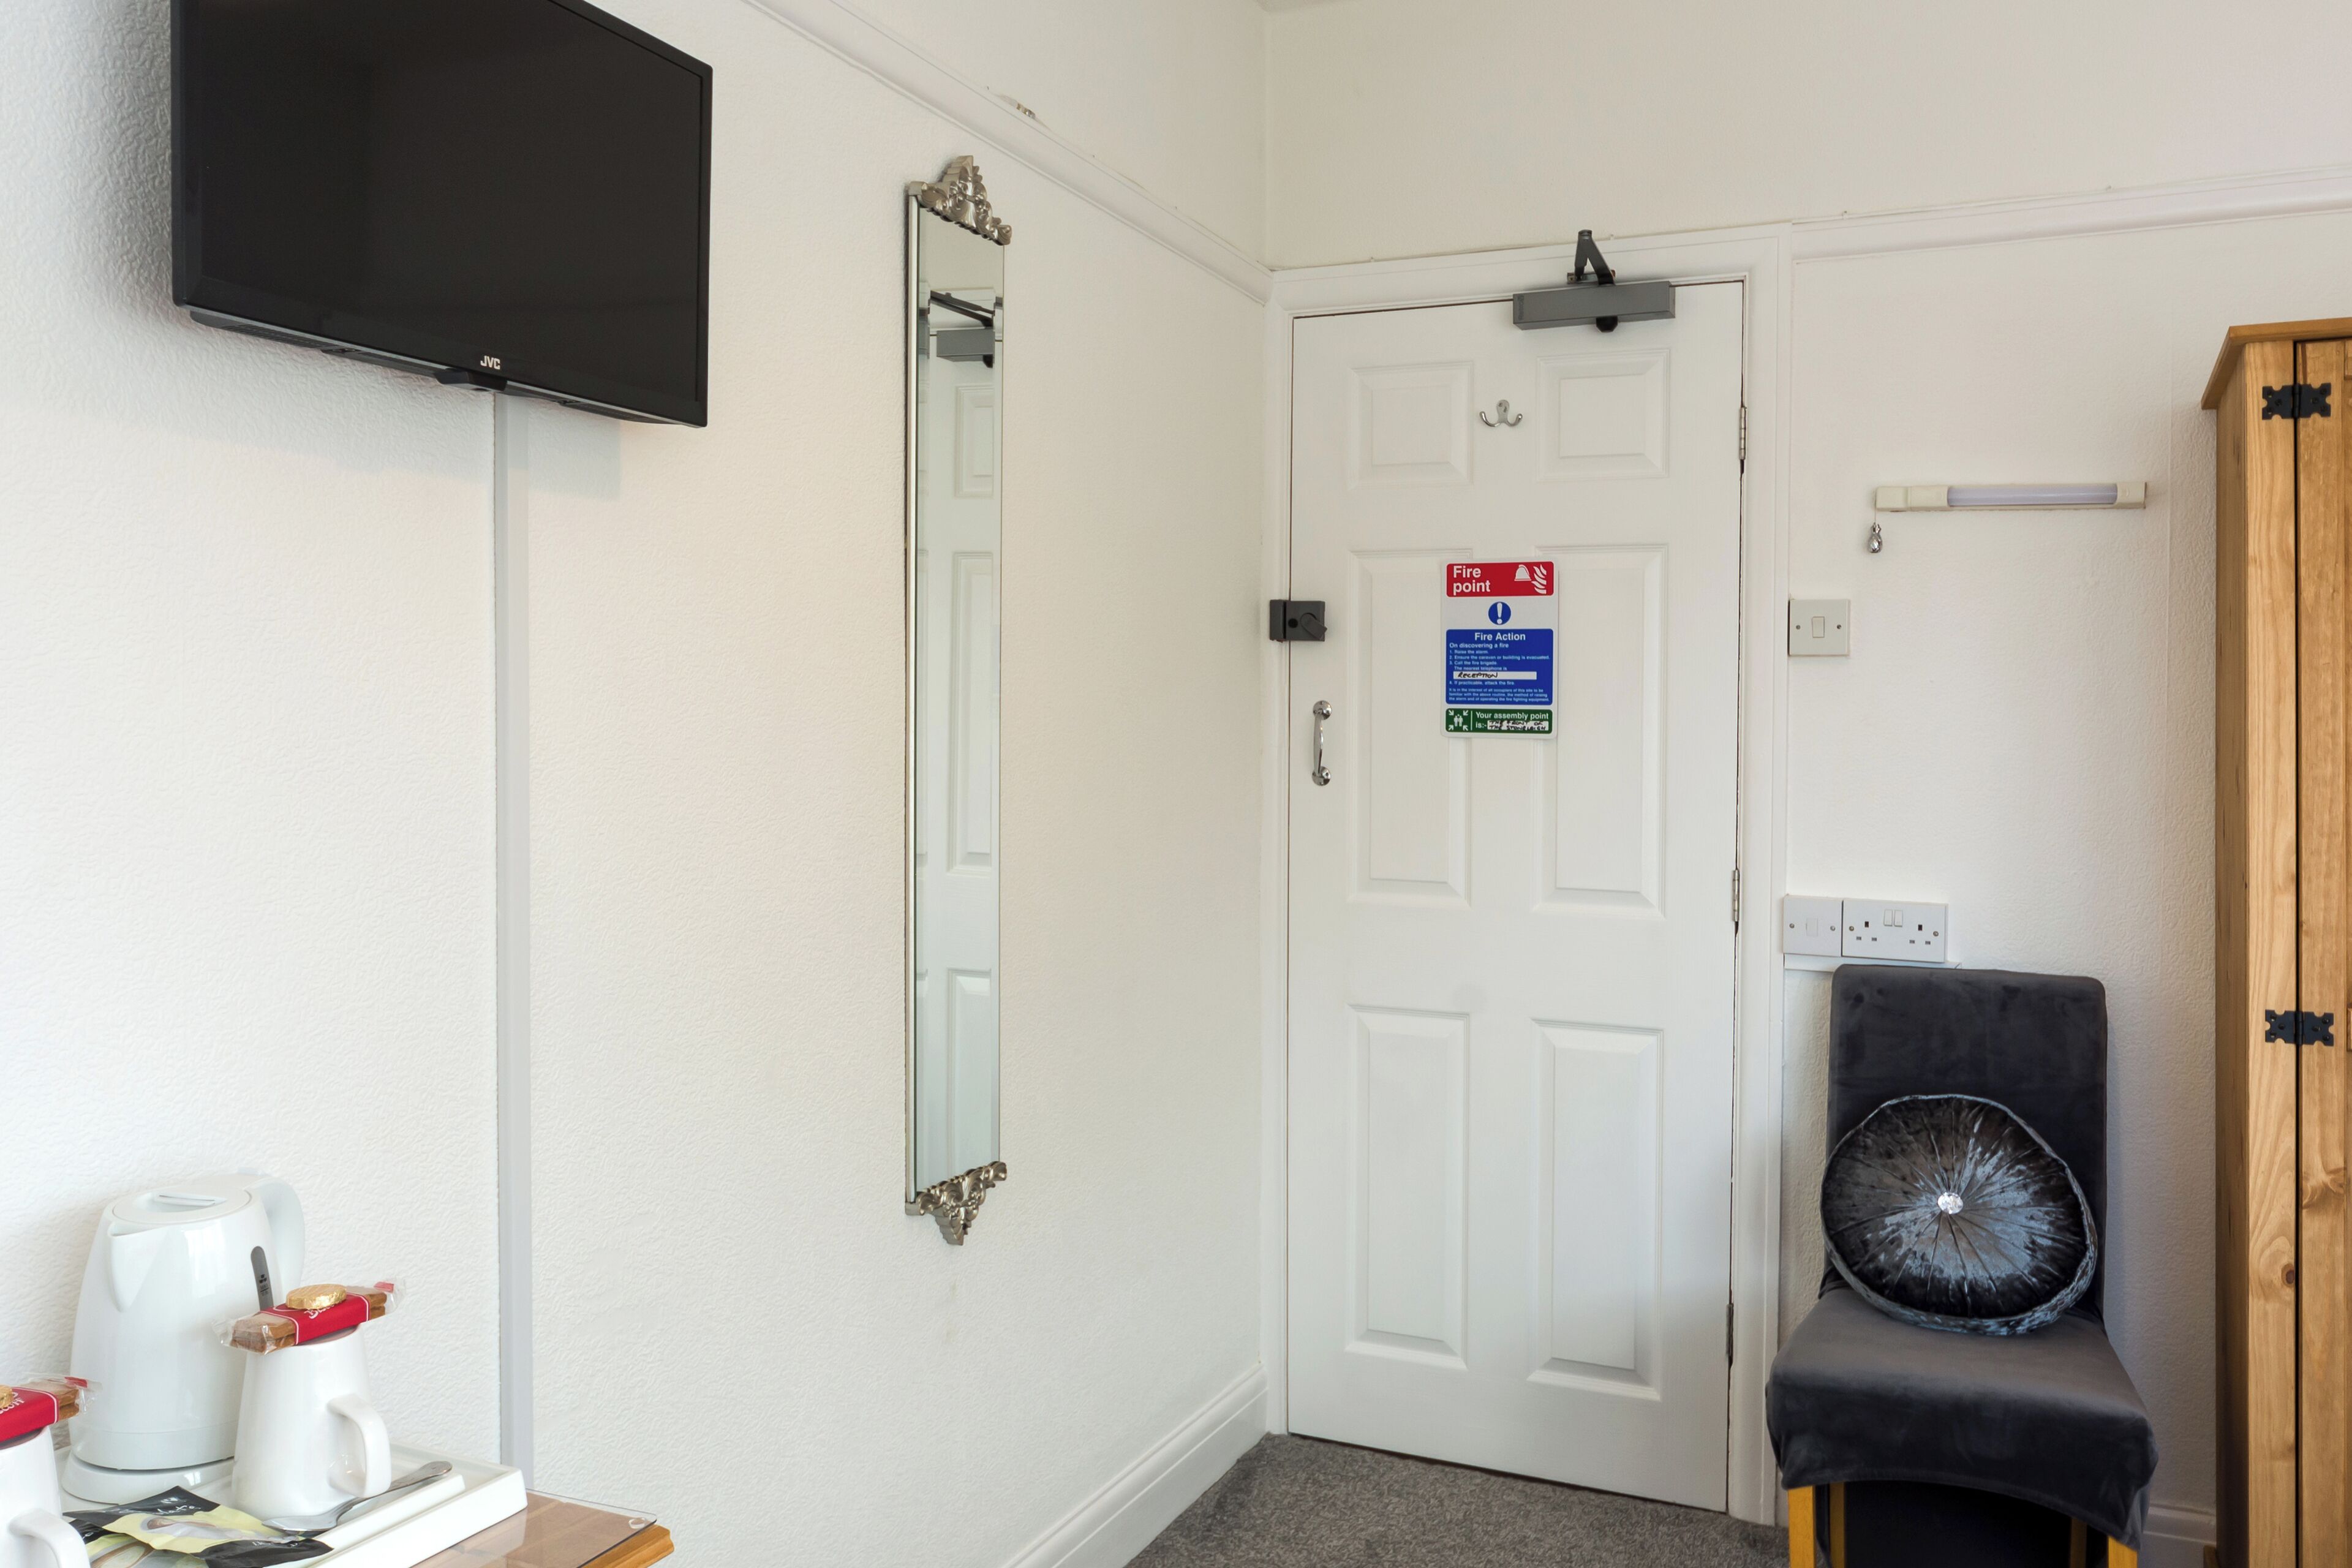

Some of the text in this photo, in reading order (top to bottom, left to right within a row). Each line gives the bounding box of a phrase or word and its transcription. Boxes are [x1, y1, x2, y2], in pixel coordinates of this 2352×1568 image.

[480, 355, 500, 370] JVC
[1453, 565, 1481, 578] Fire
[1453, 580, 1491, 596] point
[1474, 632, 1526, 641] Fire Action
